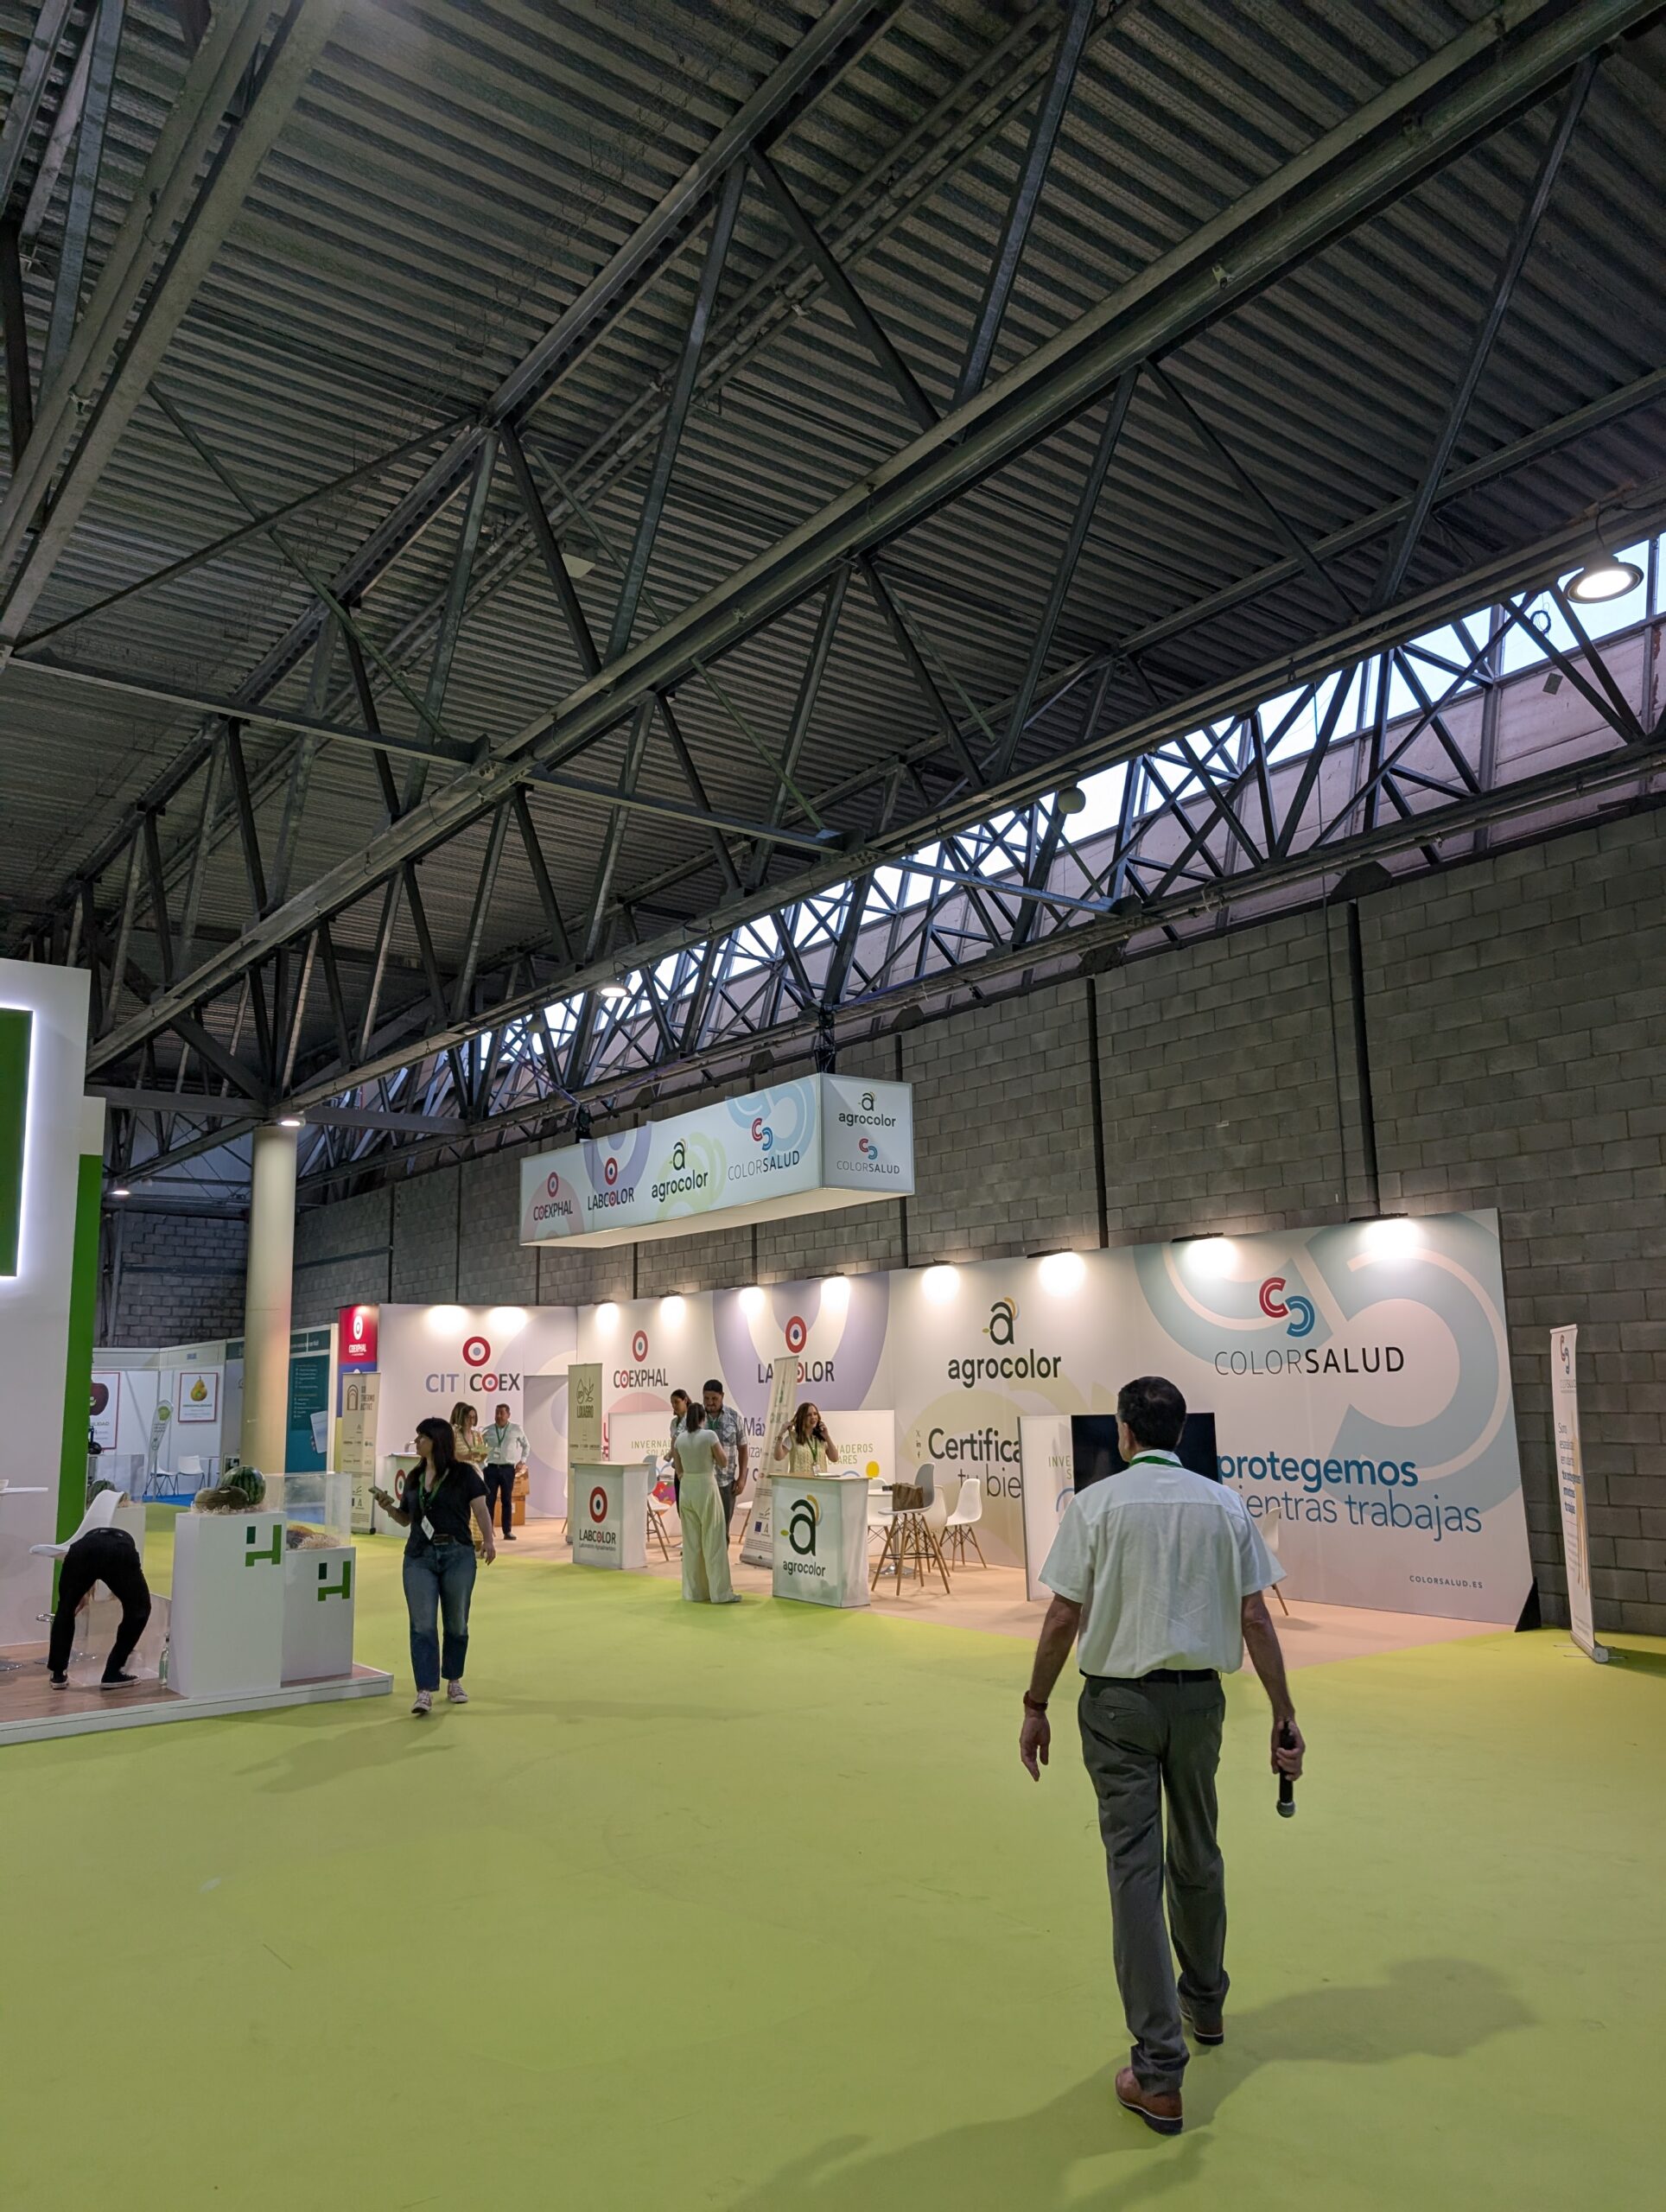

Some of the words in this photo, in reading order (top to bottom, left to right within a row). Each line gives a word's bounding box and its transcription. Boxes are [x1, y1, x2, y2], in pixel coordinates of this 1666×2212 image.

[838, 1112, 896, 1128] agrocolor
[728, 1150, 800, 1181] COLORSALUD
[836, 1160, 900, 1175] COLORSALUD
[652, 1170, 709, 1203] agrocolor
[588, 1186, 635, 1211] LABCOLOR
[533, 1199, 574, 1221] COEXPHAL
[948, 1349, 1062, 1389] agrocolor
[1214, 1345, 1405, 1376] COLORSALUD
[425, 1373, 460, 1393] CIT
[469, 1372, 521, 1393] COEX
[613, 1368, 669, 1389] COEXPHAL
[758, 1361, 835, 1383] LAOLOR
[836, 1443, 874, 1454] ADEROS
[1217, 1452, 1419, 1492] protegemos
[1239, 1484, 1338, 1523] entras
[1345, 1489, 1483, 1541] trabajas
[579, 1529, 616, 1544] LABCOLOR
[783, 1560, 826, 1579] agrocolor
[1408, 1574, 1484, 1589] COLORSALUD.ES
